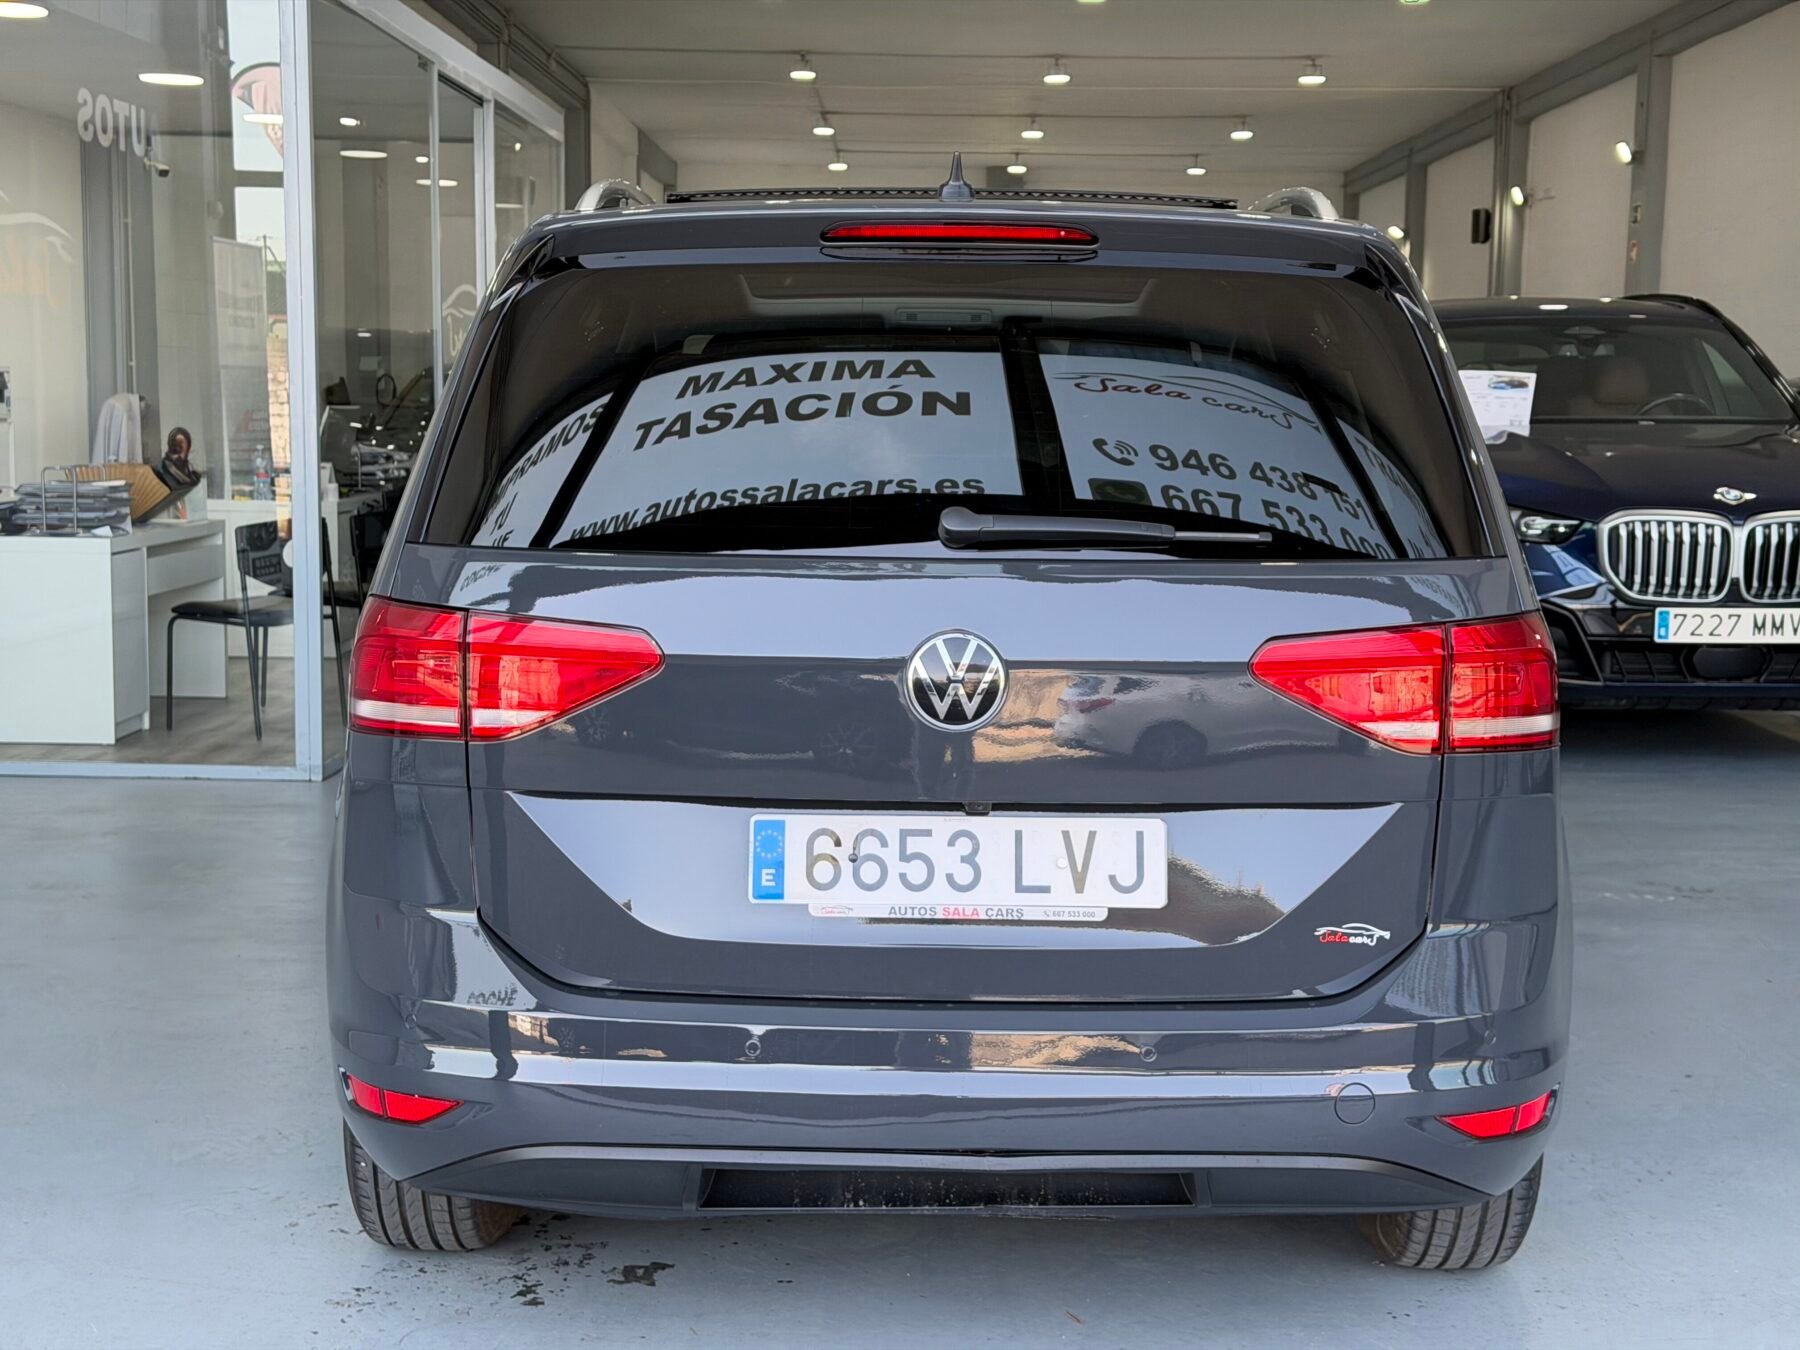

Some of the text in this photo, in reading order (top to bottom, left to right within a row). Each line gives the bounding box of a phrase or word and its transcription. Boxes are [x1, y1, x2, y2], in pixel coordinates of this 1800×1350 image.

[675, 359, 936, 400] MAXIMA
[633, 384, 972, 451] TASACIÓN
[1073, 378, 1292, 430] Sala cars
[1148, 444, 1238, 480] 946
[1249, 461, 1318, 501] 438
[1160, 484, 1242, 520] 667
[1673, 613, 1742, 637] 7227
[761, 870, 776, 887] E
[805, 827, 1145, 895] 6653 LVJ
[888, 906, 1024, 920] AUTOS SALA CARS
